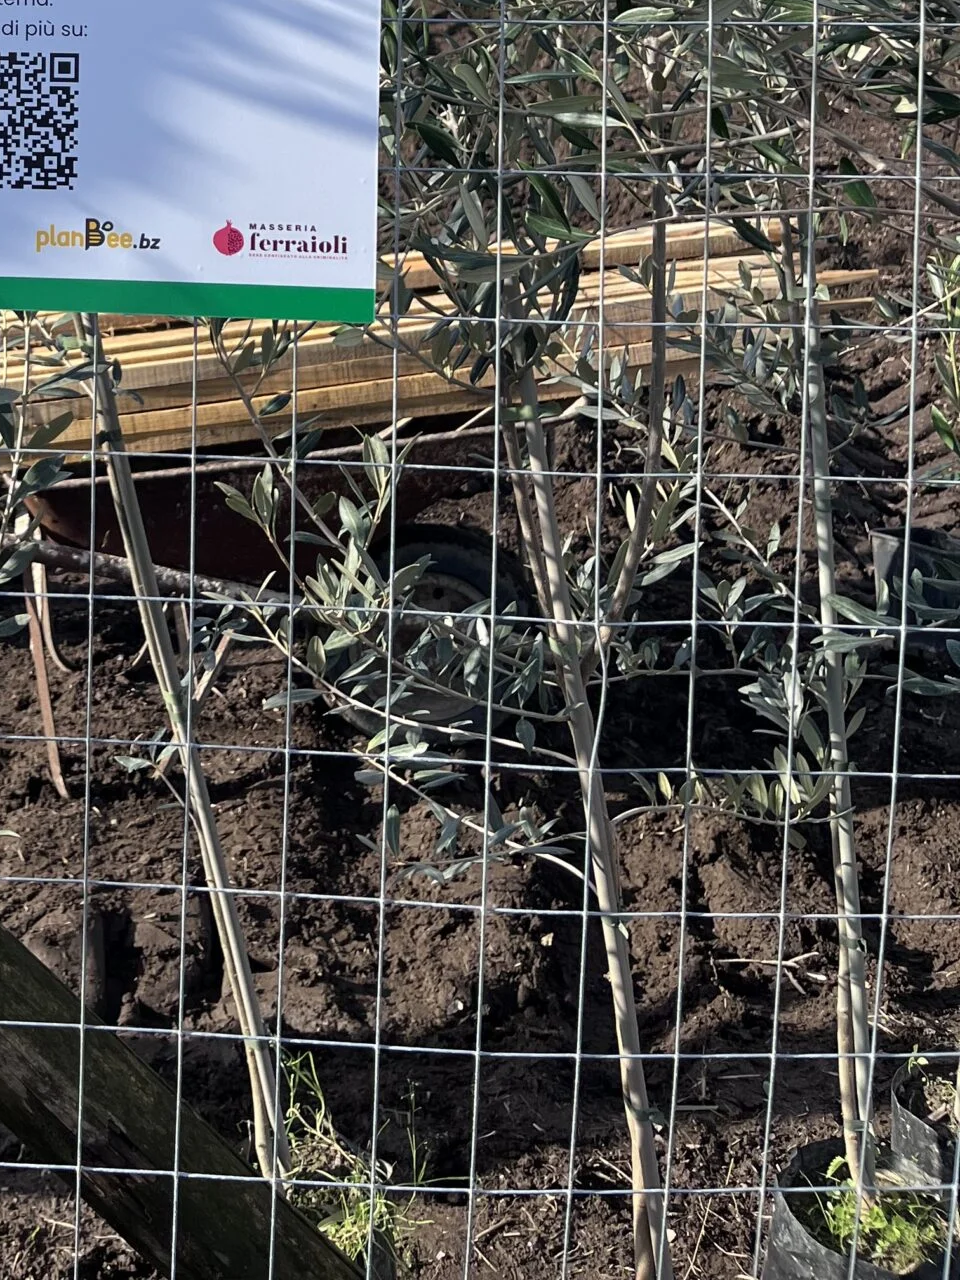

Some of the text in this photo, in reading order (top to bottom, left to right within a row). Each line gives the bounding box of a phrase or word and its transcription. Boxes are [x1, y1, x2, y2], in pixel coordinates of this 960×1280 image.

[1, 19, 19, 37] di
[25, 19, 55, 42] più
[61, 24, 88, 38] su:
[248, 222, 318, 233] MASSERIA
[249, 232, 348, 255] ferraioli
